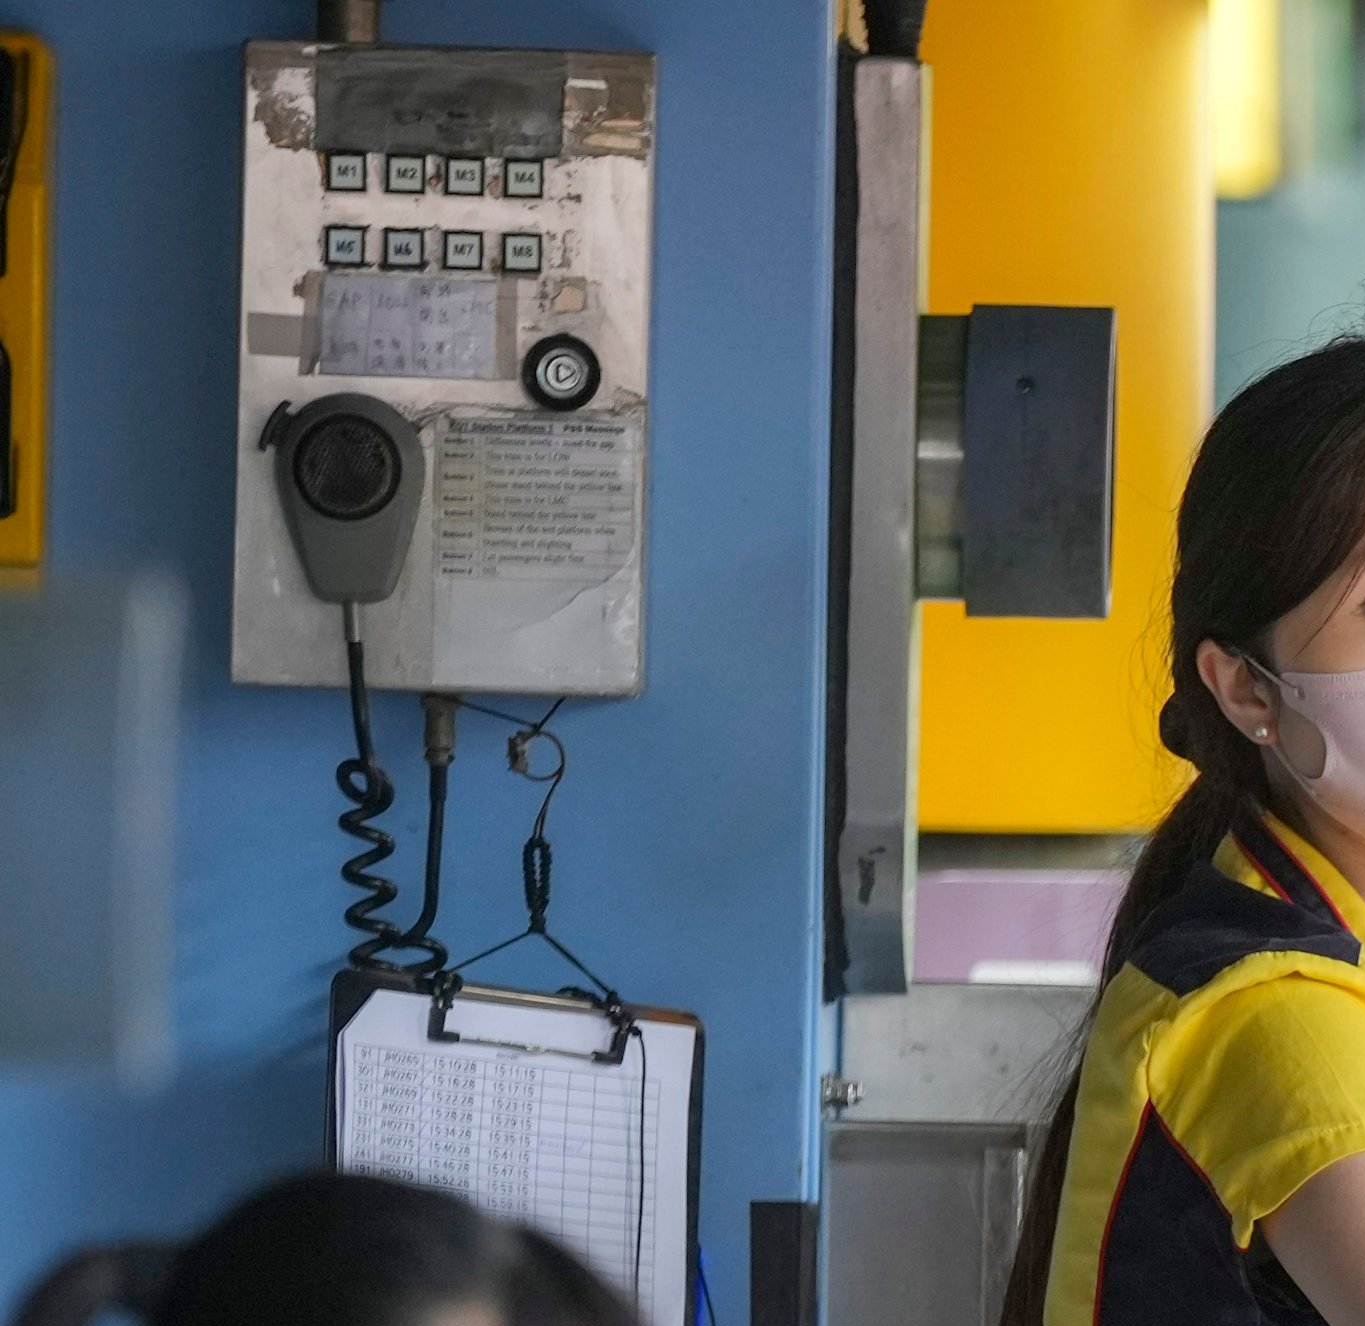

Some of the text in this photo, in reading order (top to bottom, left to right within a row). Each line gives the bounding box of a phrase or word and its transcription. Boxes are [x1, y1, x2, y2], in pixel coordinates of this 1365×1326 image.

[337, 166, 357, 177] M1
[396, 168, 418, 180] M2
[454, 169, 476, 182] M3
[514, 172, 535, 184] M4
[453, 243, 475, 256] M7
[512, 245, 534, 258] M8
[354, 1164, 371, 1175] 191
